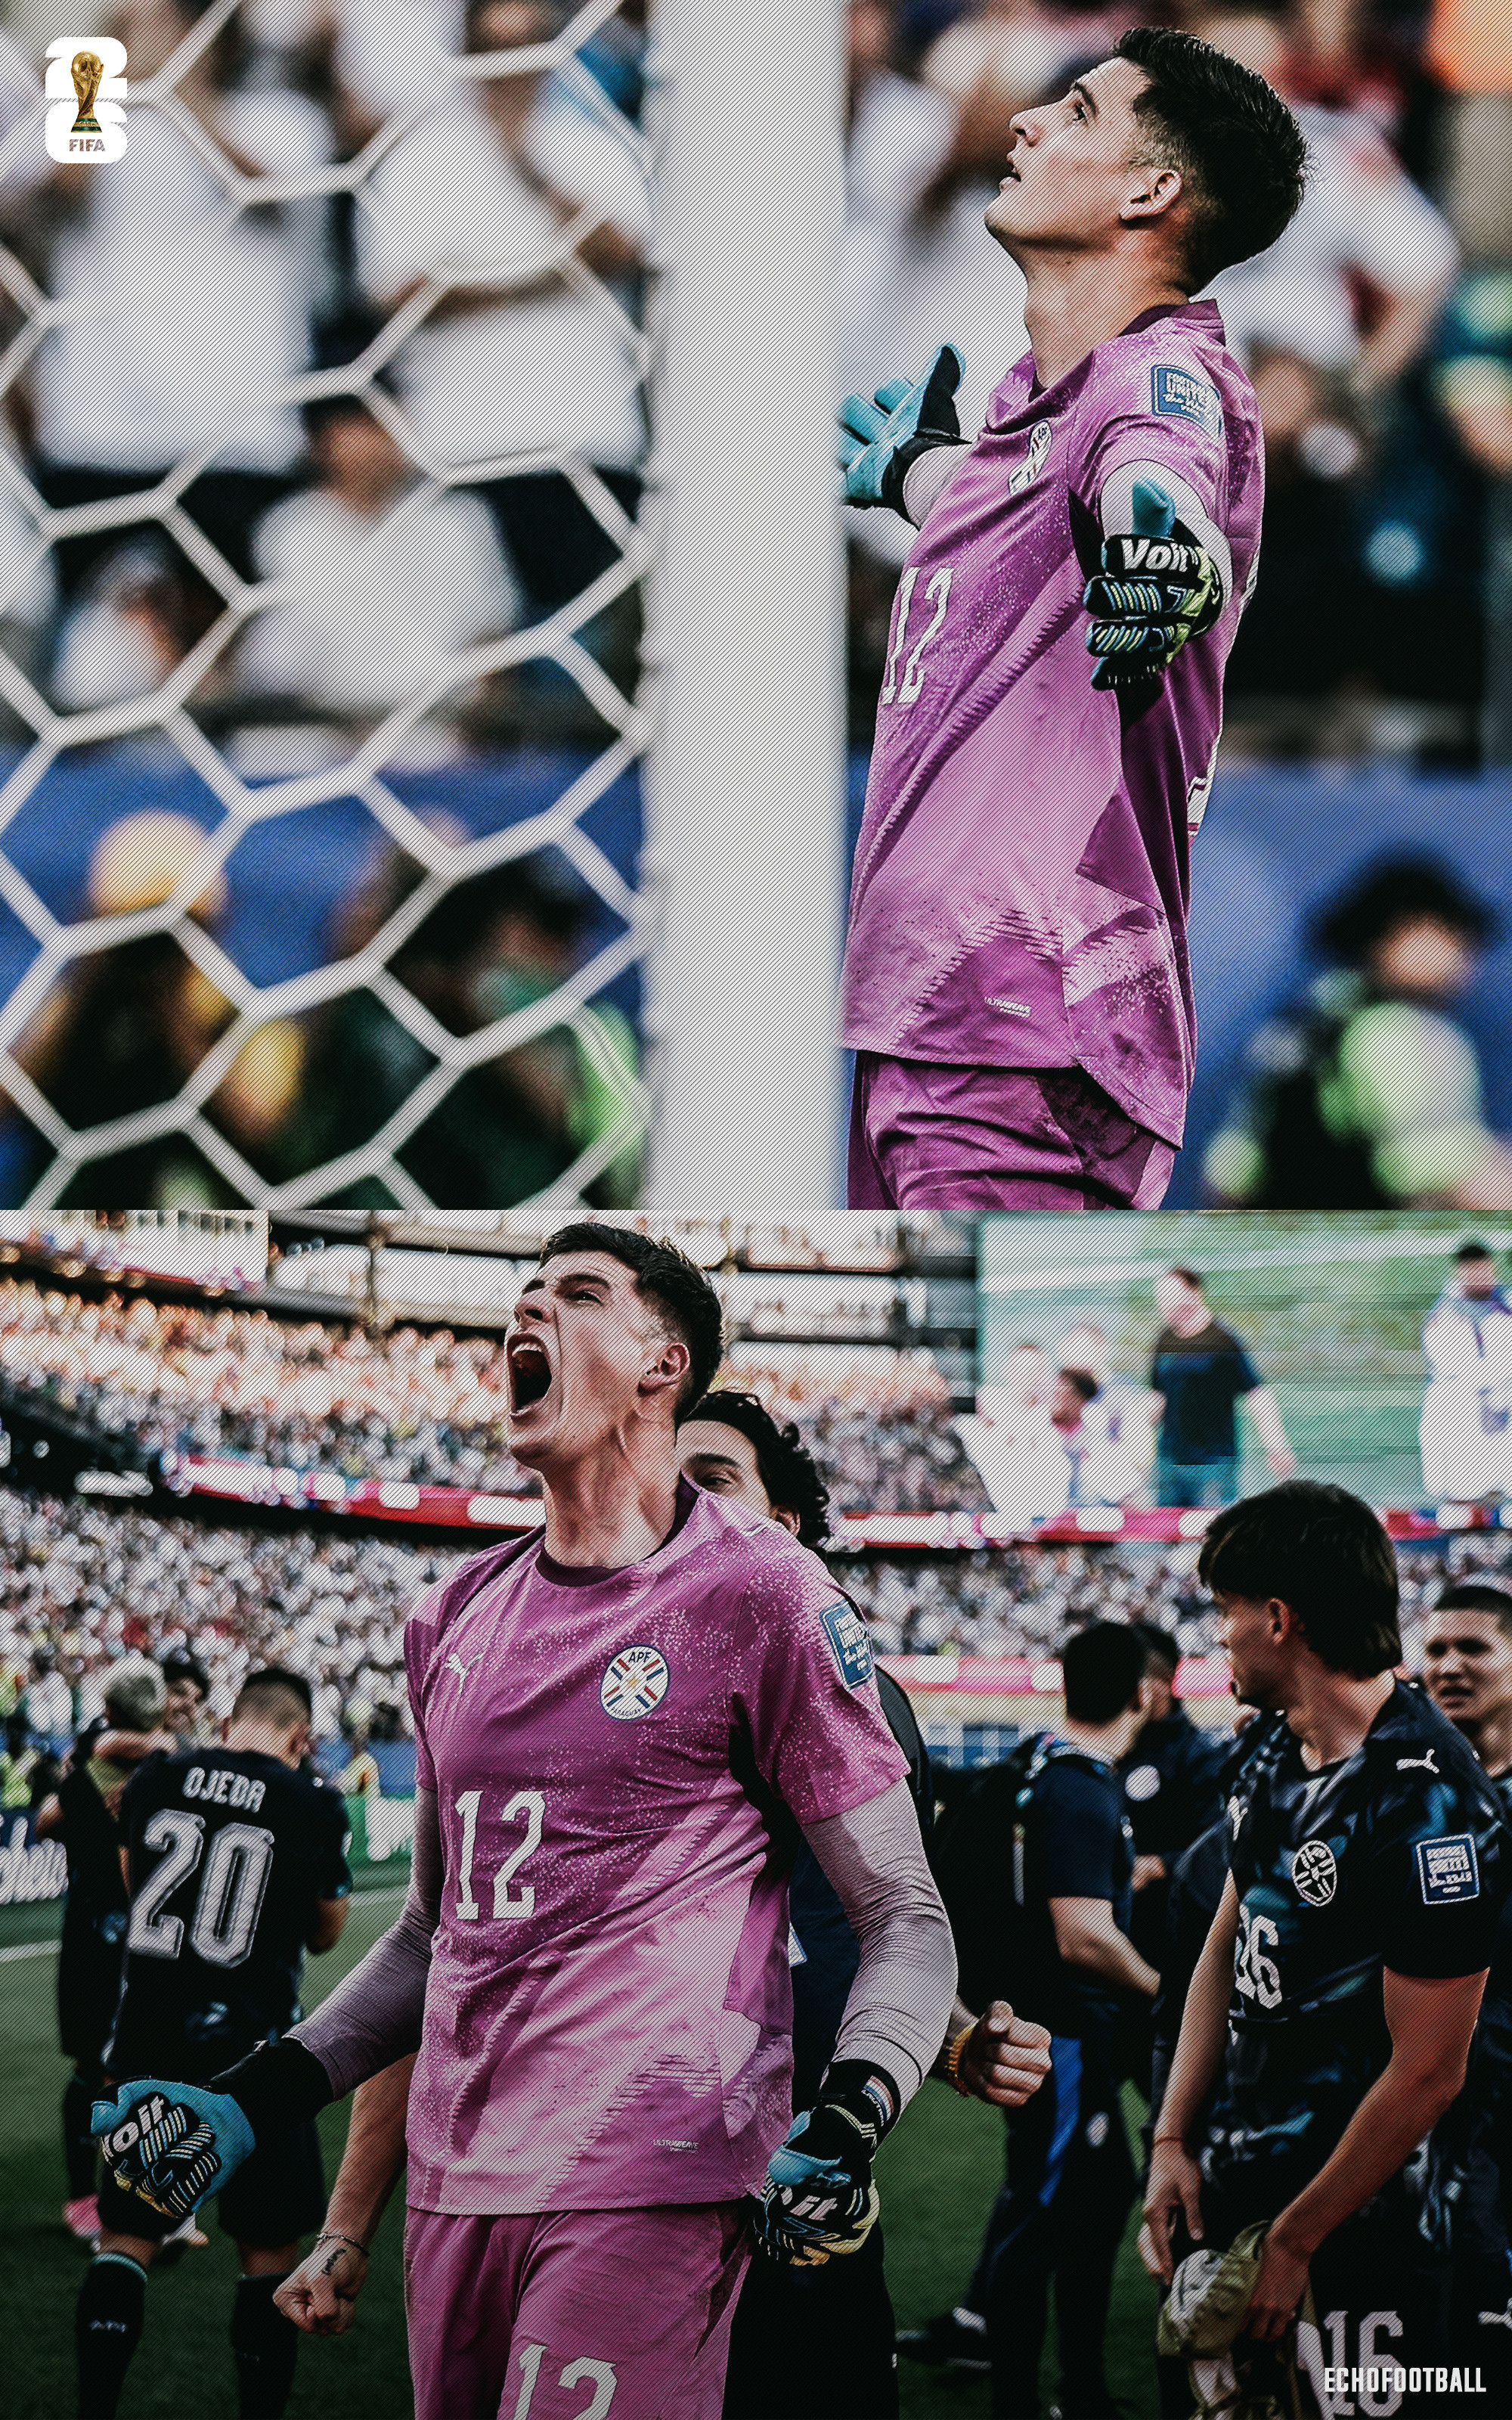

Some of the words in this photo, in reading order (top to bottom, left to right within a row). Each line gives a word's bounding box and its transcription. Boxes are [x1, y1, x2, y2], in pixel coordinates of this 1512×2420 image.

[881, 566, 955, 706] 12
[628, 1651, 652, 1663] APF
[182, 1767, 267, 1813] OJEDA
[127, 1808, 275, 1969] 20
[454, 1790, 546, 1920] 12
[513, 2344, 618, 2420] 12
[1323, 2310, 1404, 2418] 16
